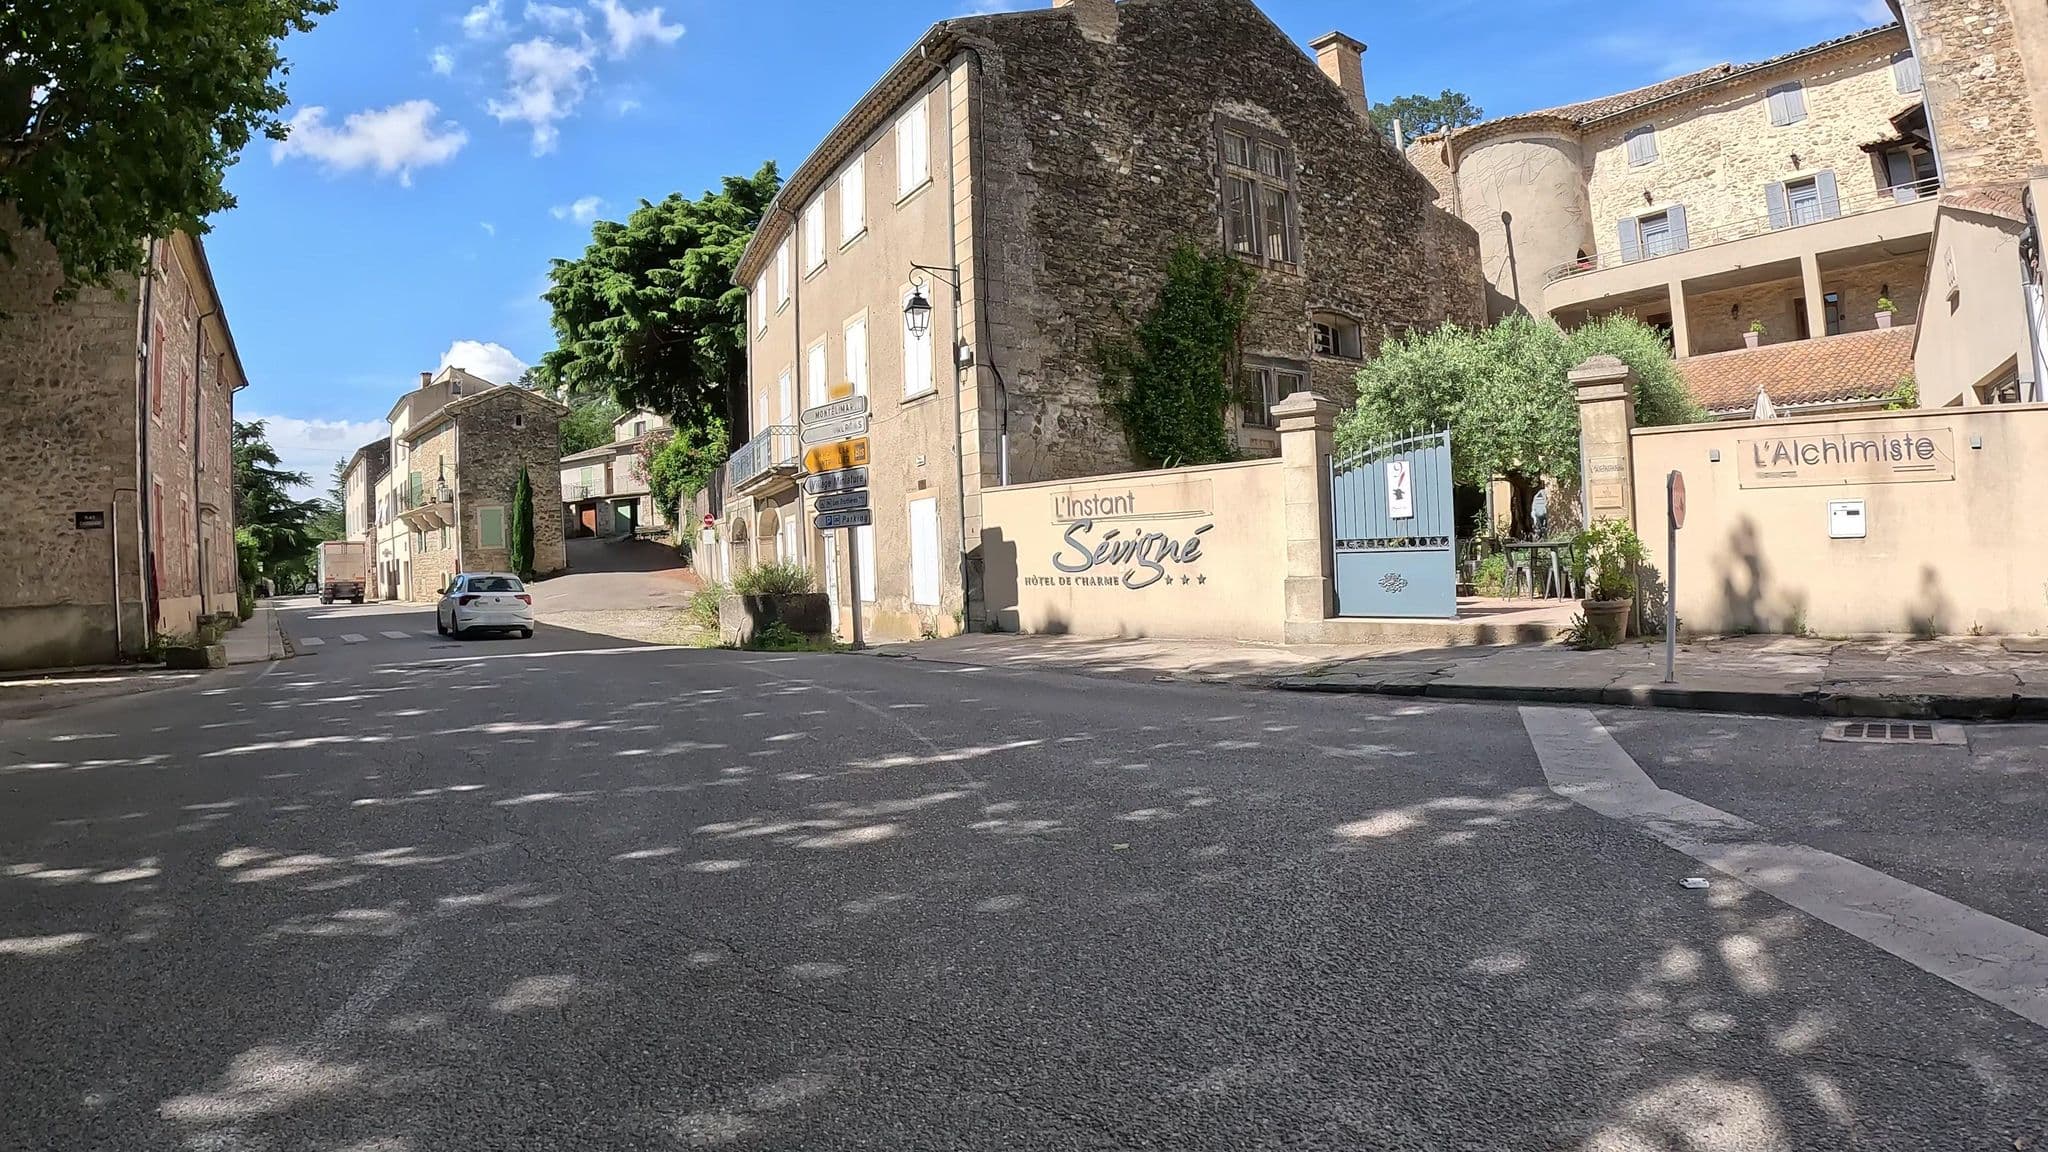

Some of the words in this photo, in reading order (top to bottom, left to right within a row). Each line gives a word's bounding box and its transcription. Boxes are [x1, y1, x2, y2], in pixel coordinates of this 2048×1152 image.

[1753, 432, 1936, 468] L'Alchimiste
[1054, 490, 1136, 518] L'Instant
[1052, 518, 1214, 589] Sévigné
[1024, 574, 1055, 586] HÔTEL
[1058, 576, 1072, 586] DE
[1075, 576, 1120, 586] CHARME
